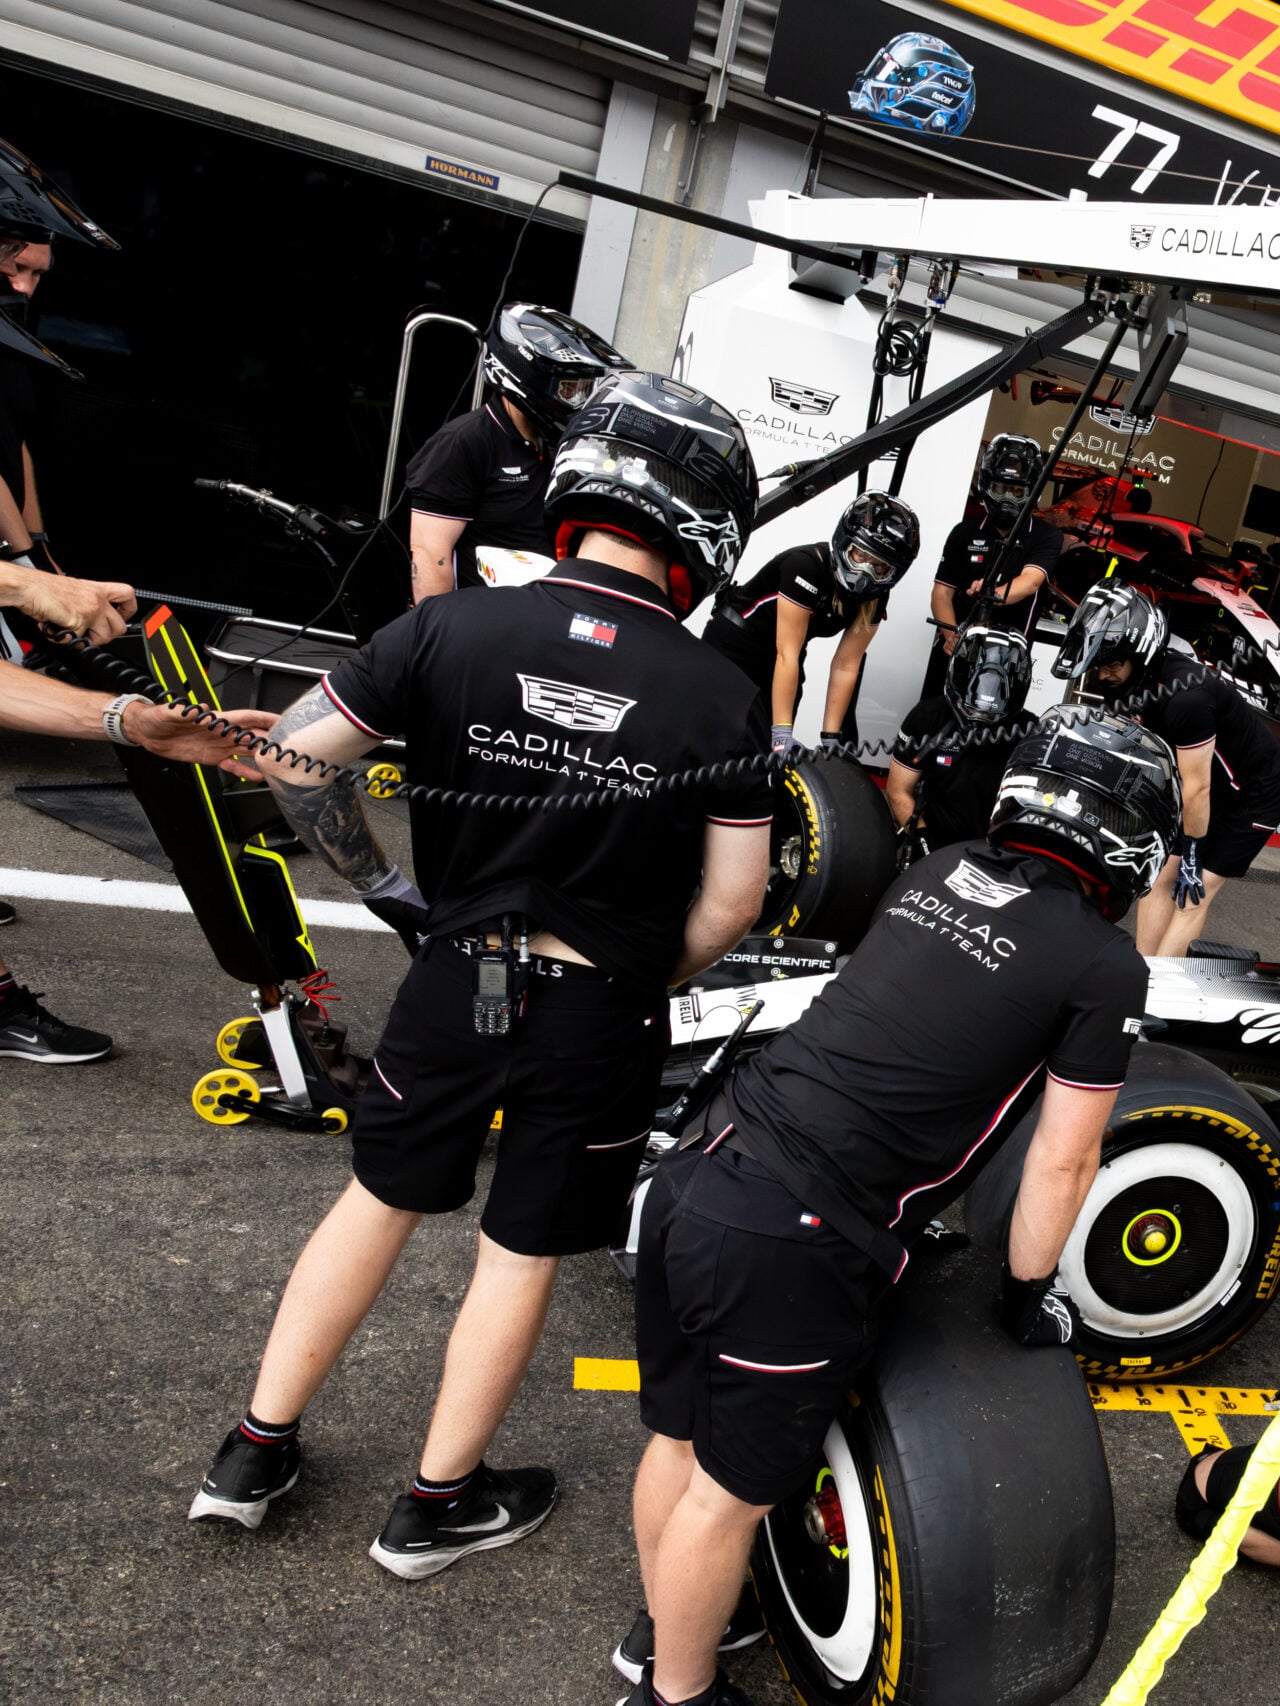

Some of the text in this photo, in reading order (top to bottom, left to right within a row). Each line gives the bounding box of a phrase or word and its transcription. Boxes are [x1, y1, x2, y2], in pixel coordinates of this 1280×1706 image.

[1088, 104, 1180, 194] 77
[744, 427, 800, 446] ORMULA
[576, 614, 617, 629] TOMMY
[569, 633, 611, 647] HILFIGER
[468, 725, 658, 781] CADILLAC
[468, 746, 570, 776] FORMULA
[901, 890, 1016, 957] CADILLAC
[886, 907, 937, 930] FORMULA
[951, 932, 999, 971] TEAM
[724, 953, 832, 968] CORE SCIENTIFIC
